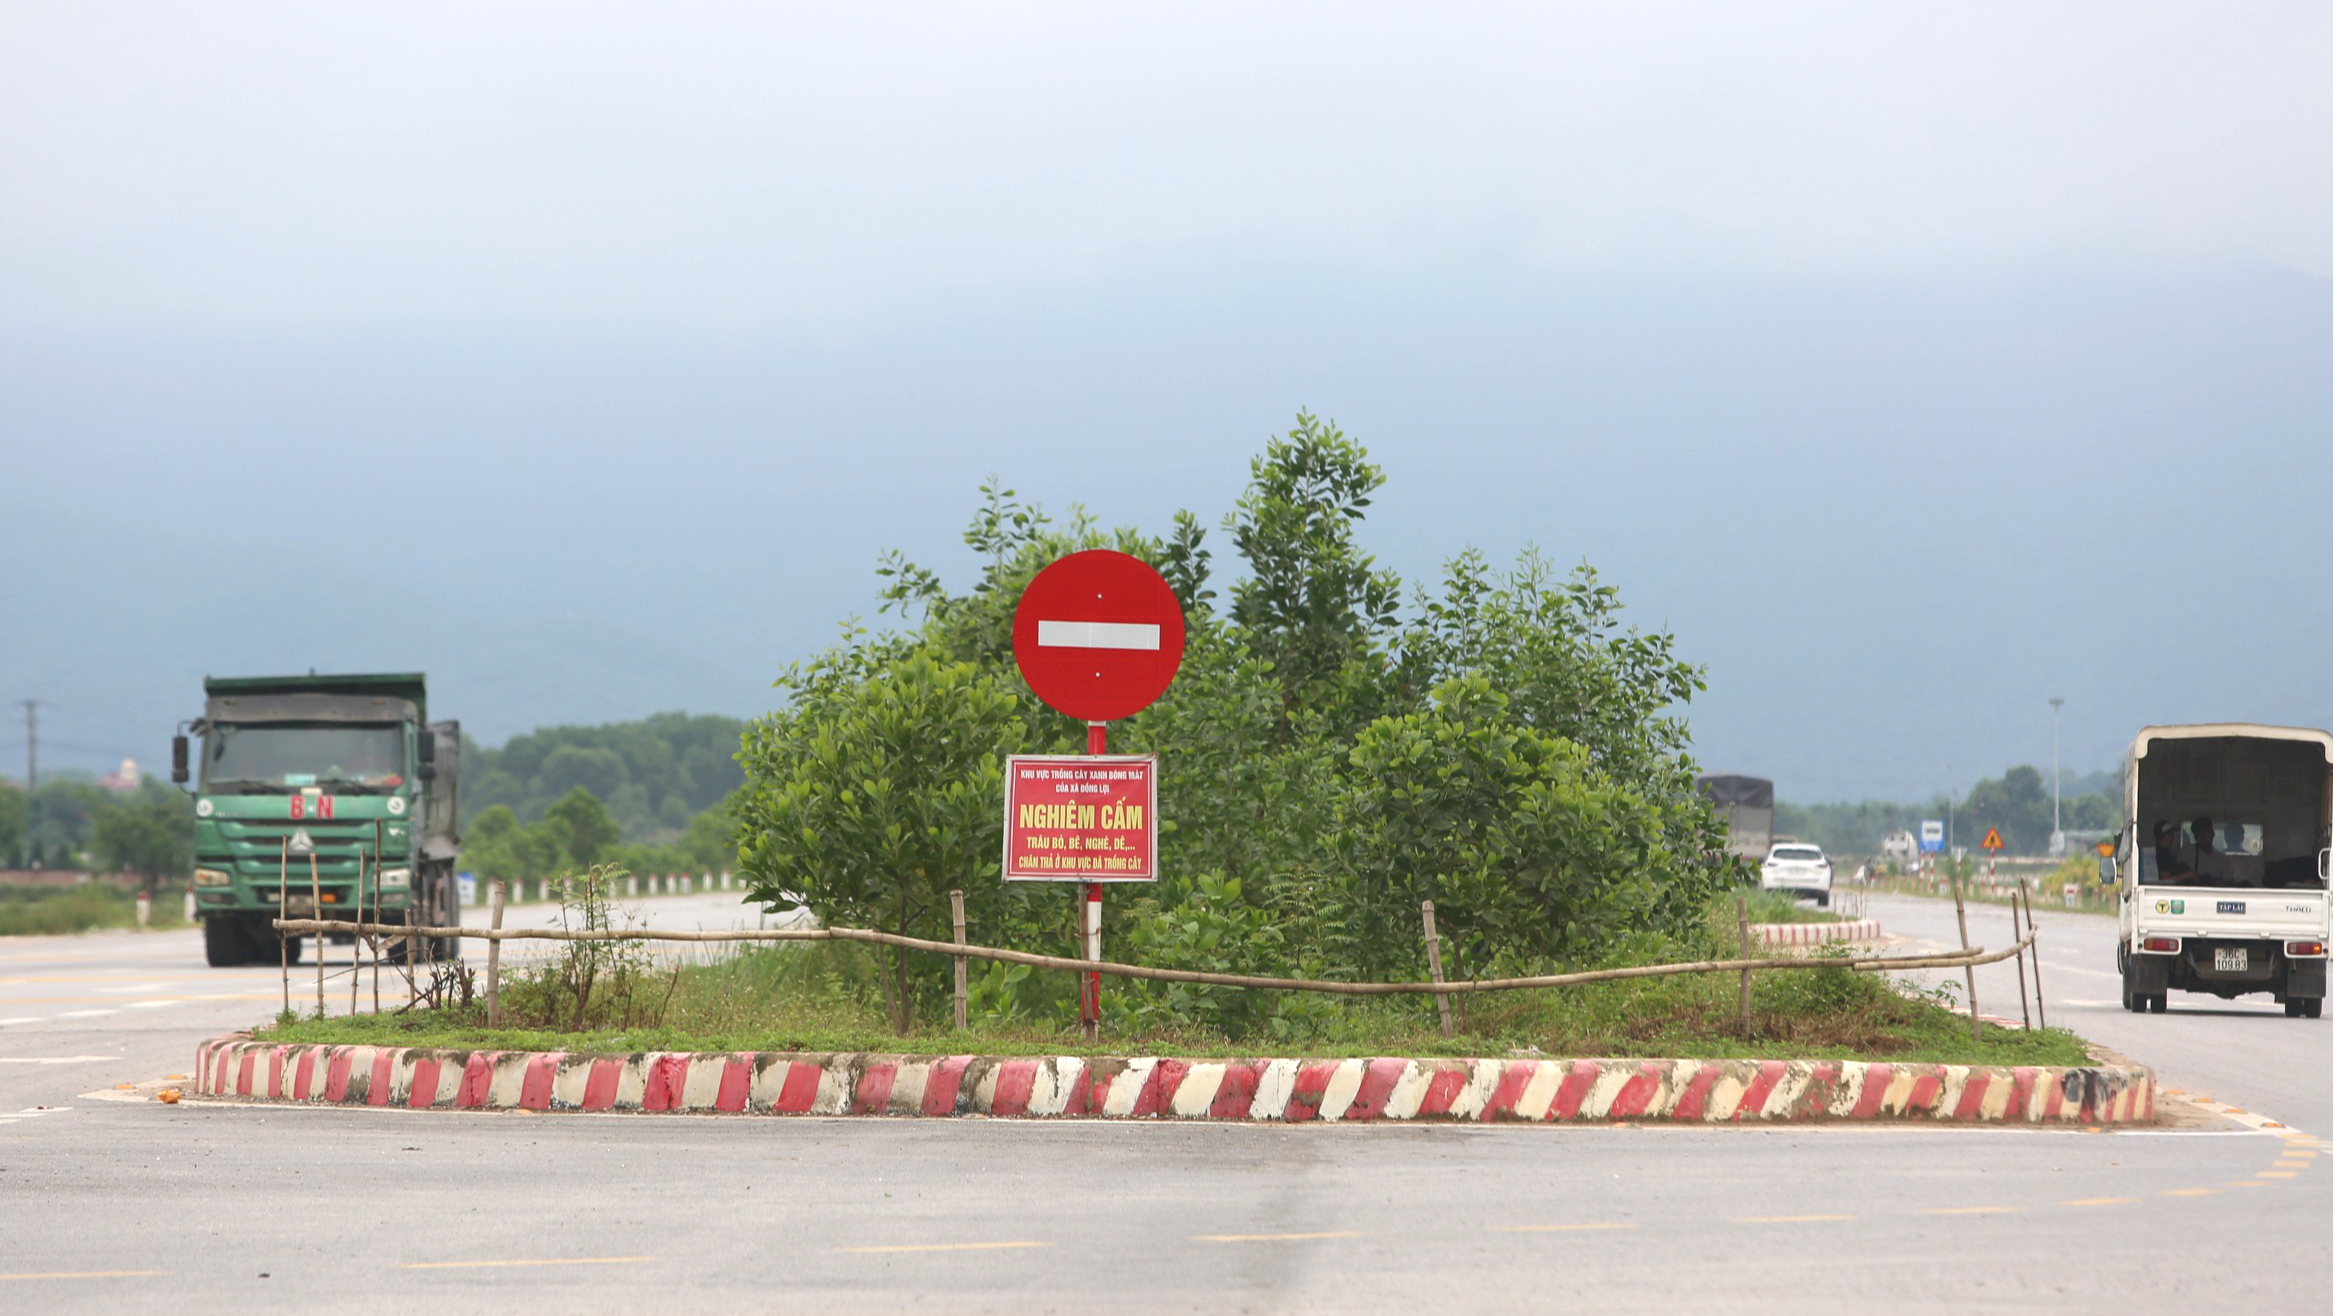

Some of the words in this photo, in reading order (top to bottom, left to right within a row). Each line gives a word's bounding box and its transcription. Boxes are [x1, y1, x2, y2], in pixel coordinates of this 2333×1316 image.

[1021, 769, 1034, 779] KHU
[1036, 769, 1050, 781] VỰC
[1074, 769, 1088, 780] CÂY
[1089, 770, 1108, 780] XANH
[1108, 769, 1127, 780] BÓNG
[1055, 781, 1069, 793] CỦA
[1070, 782, 1079, 793] XÃ
[1019, 799, 1095, 829] NGHIÊM
[1101, 796, 1143, 830] CẤM
[1027, 834, 1050, 849] TRÂU
[1068, 835, 1083, 851] BÊ,
[1039, 853, 1054, 869] THẢ
[1054, 853, 1061, 869] Ở
[1061, 856, 1076, 869] KHU
[1077, 856, 1091, 872] VỰC
[1092, 855, 1103, 870] ĐÃ
[1127, 855, 1142, 870] CÂY
[2222, 948, 2240, 960] 36C
